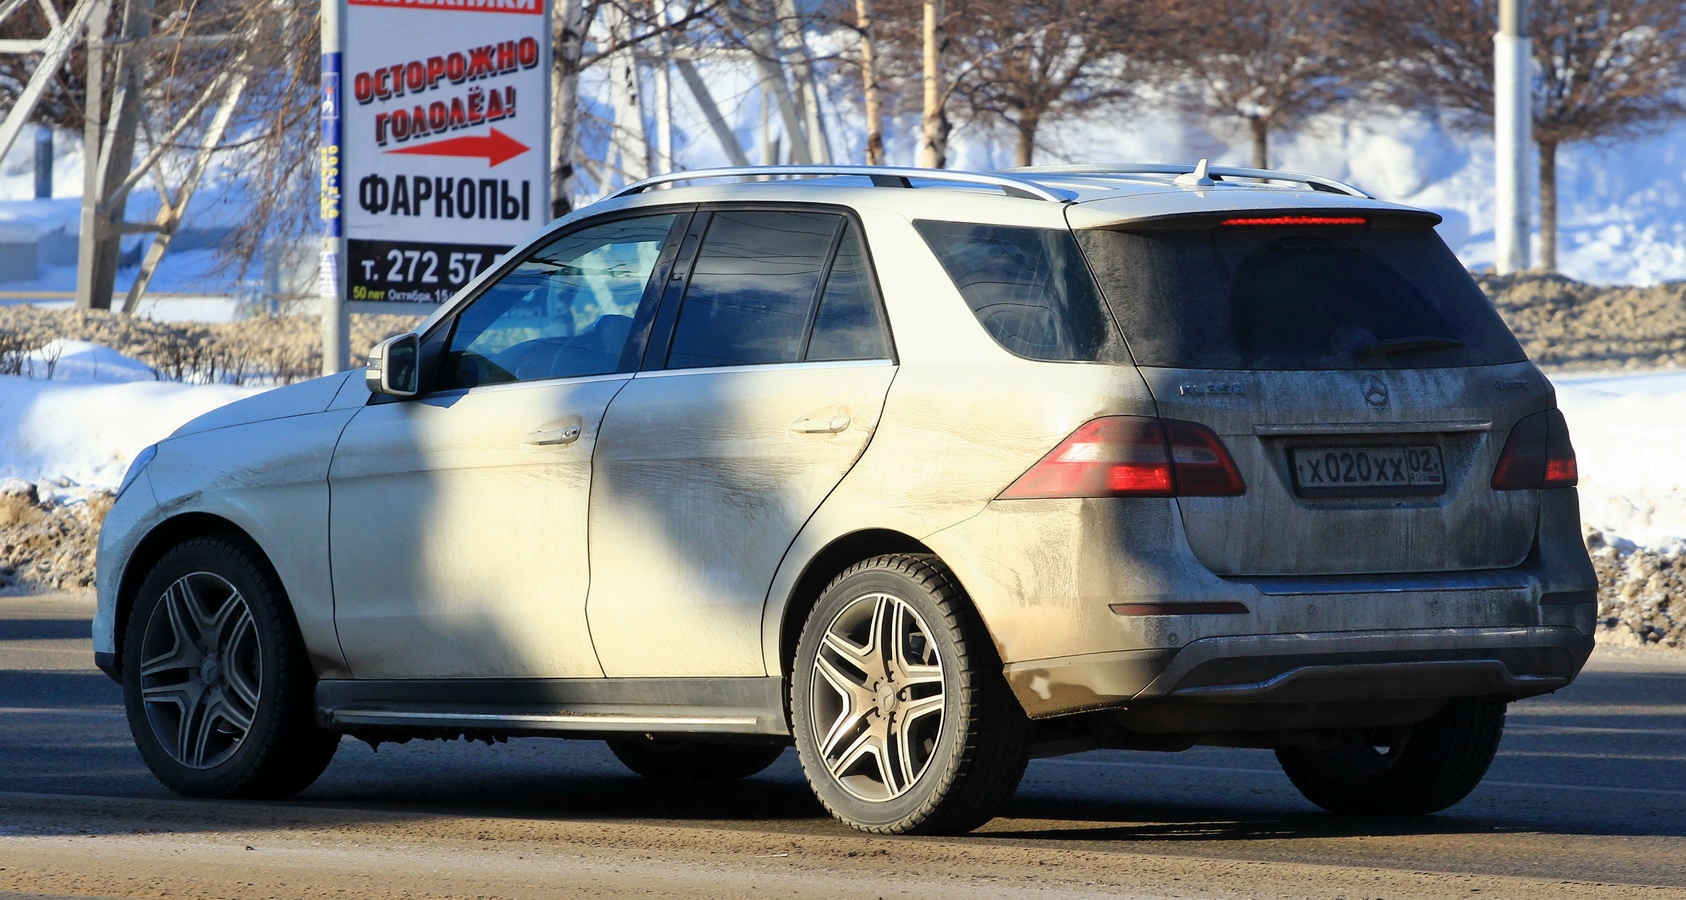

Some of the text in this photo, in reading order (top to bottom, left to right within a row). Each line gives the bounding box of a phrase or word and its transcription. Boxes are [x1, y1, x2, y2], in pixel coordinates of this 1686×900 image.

[354, 37, 539, 104] ОСТОРОЖНО
[375, 86, 515, 145] ГОЛОЛЁД!
[359, 174, 530, 221] ФАРКОПЫ
[386, 249, 439, 284] 272
[448, 252, 483, 285] 57
[353, 285, 367, 300] 50
[367, 290, 385, 301] лет
[1408, 449, 1433, 472] 02
[1410, 473, 1428, 482] RUS
